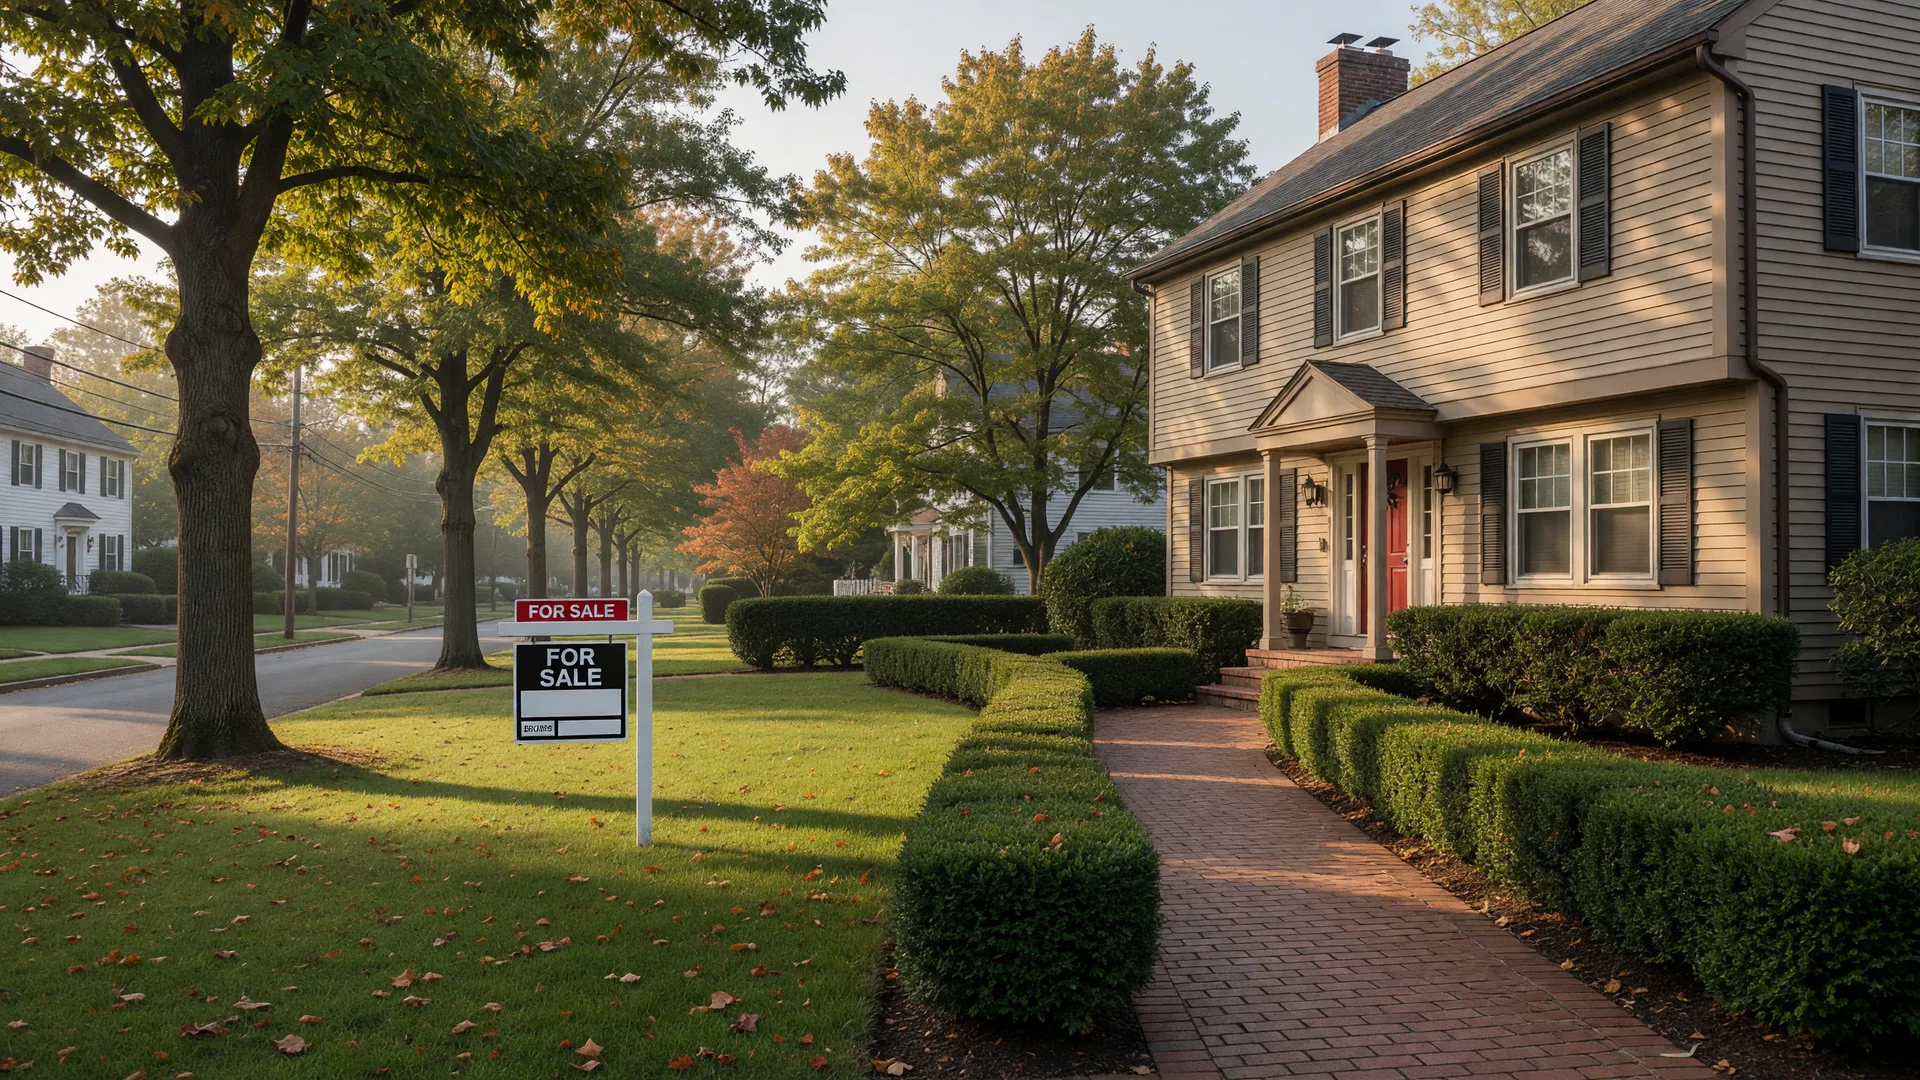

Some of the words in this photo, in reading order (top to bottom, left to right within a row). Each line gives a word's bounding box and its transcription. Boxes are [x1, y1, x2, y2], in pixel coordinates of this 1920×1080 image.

[528, 604, 565, 619] FOR
[570, 603, 615, 618] SALE
[546, 648, 595, 667] FOR
[539, 668, 602, 687] SALE
